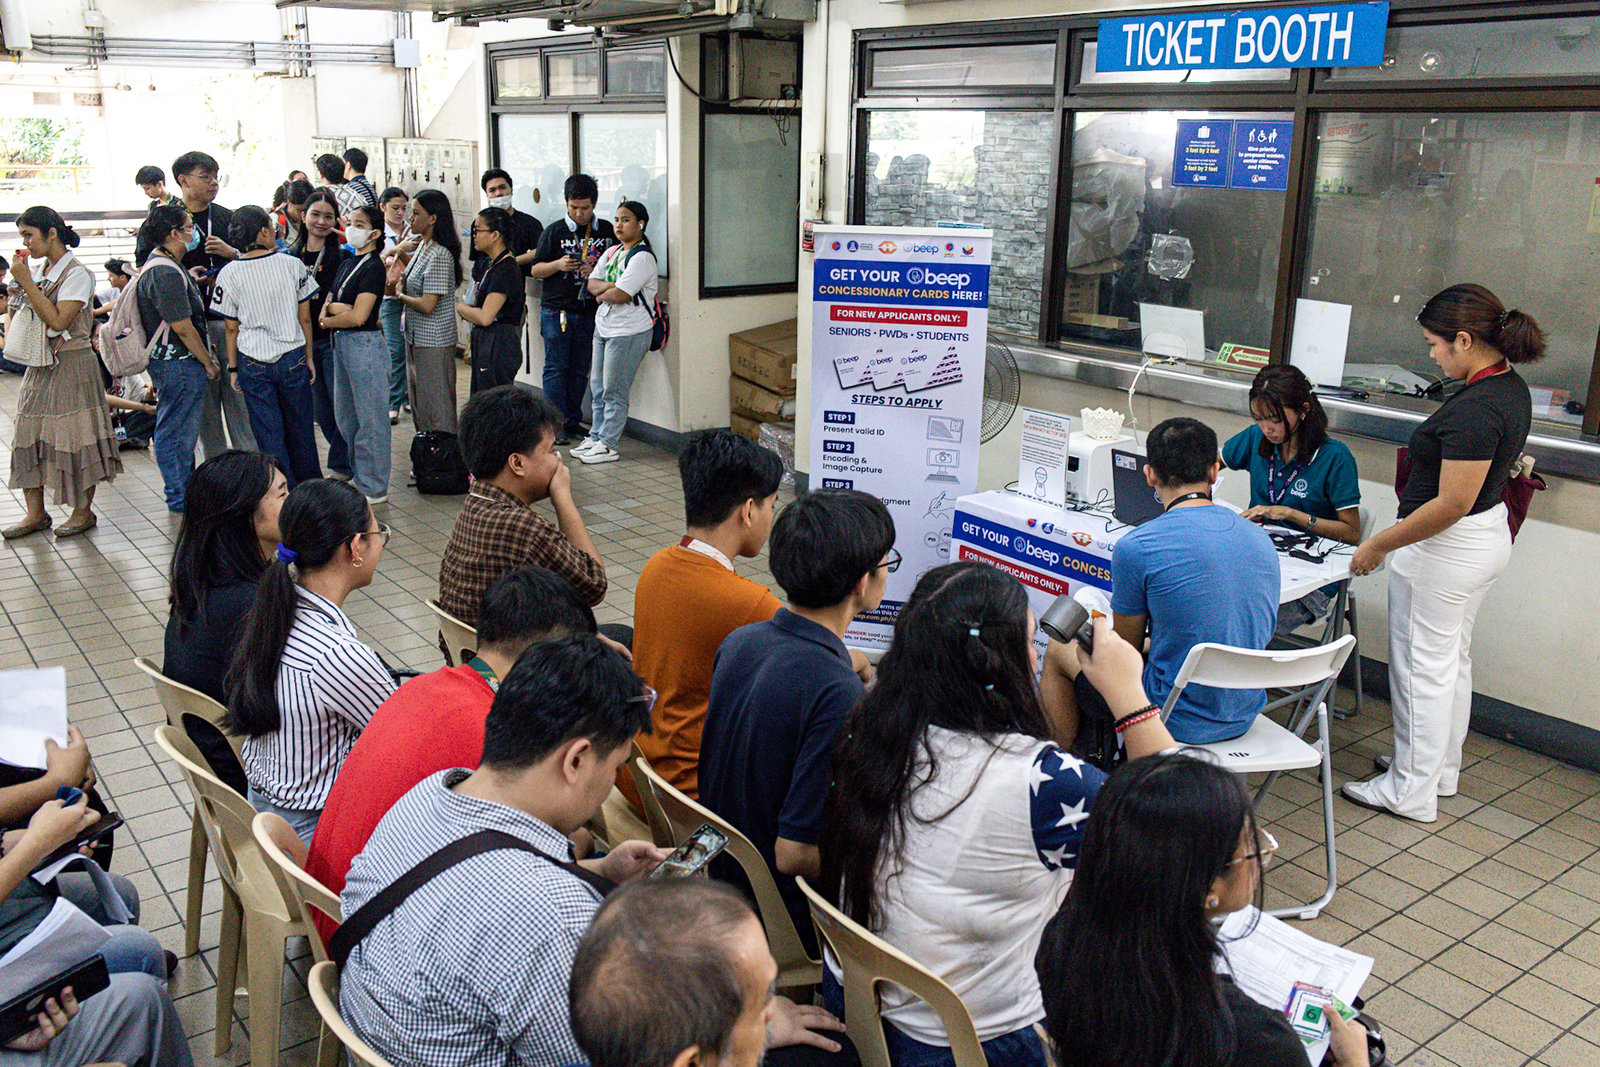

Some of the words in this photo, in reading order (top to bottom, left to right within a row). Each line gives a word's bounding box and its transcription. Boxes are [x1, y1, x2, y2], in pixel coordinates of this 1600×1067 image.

[1122, 18, 1226, 67] TICKET
[1234, 11, 1354, 63] BOOTH
[913, 243, 939, 255] beep
[830, 268, 857, 281] GET
[860, 270, 900, 283] YOUR
[925, 268, 971, 290] beep
[212, 286, 224, 305] 9
[818, 285, 910, 298] CONCESSIONARY
[912, 288, 950, 299] CARDS
[951, 290, 983, 301] HERE!
[836, 309, 854, 318] FOR
[855, 310, 877, 319] NEW
[877, 311, 933, 322] APPLICANTS
[933, 313, 961, 323] ONLY:
[828, 327, 871, 337] SENIORS
[879, 330, 908, 339] PWDs
[916, 331, 969, 342] STUDENTS
[851, 394, 886, 405] STEPS
[887, 396, 903, 406] TO
[904, 397, 943, 408] APPLY
[827, 413, 847, 422] STEP
[847, 414, 852, 422] 1
[823, 425, 854, 434] Present
[855, 427, 875, 436] valid
[876, 428, 885, 436] ID
[826, 443, 845, 451] STEP
[822, 454, 860, 465] Encoding
[822, 463, 848, 473] Image
[850, 465, 883, 475] Capture
[825, 480, 844, 489] STEP
[1290, 488, 1307, 499] beep
[961, 521, 981, 537] GET
[982, 528, 1010, 548] YOUR
[1026, 539, 1060, 567] beep
[1062, 555, 1113, 582] CONCES
[964, 550, 979, 562] FOR
[995, 561, 1039, 585] APPLICANTS
[1040, 578, 1064, 594] ONLY:
[1306, 1008, 1316, 1020] 6
